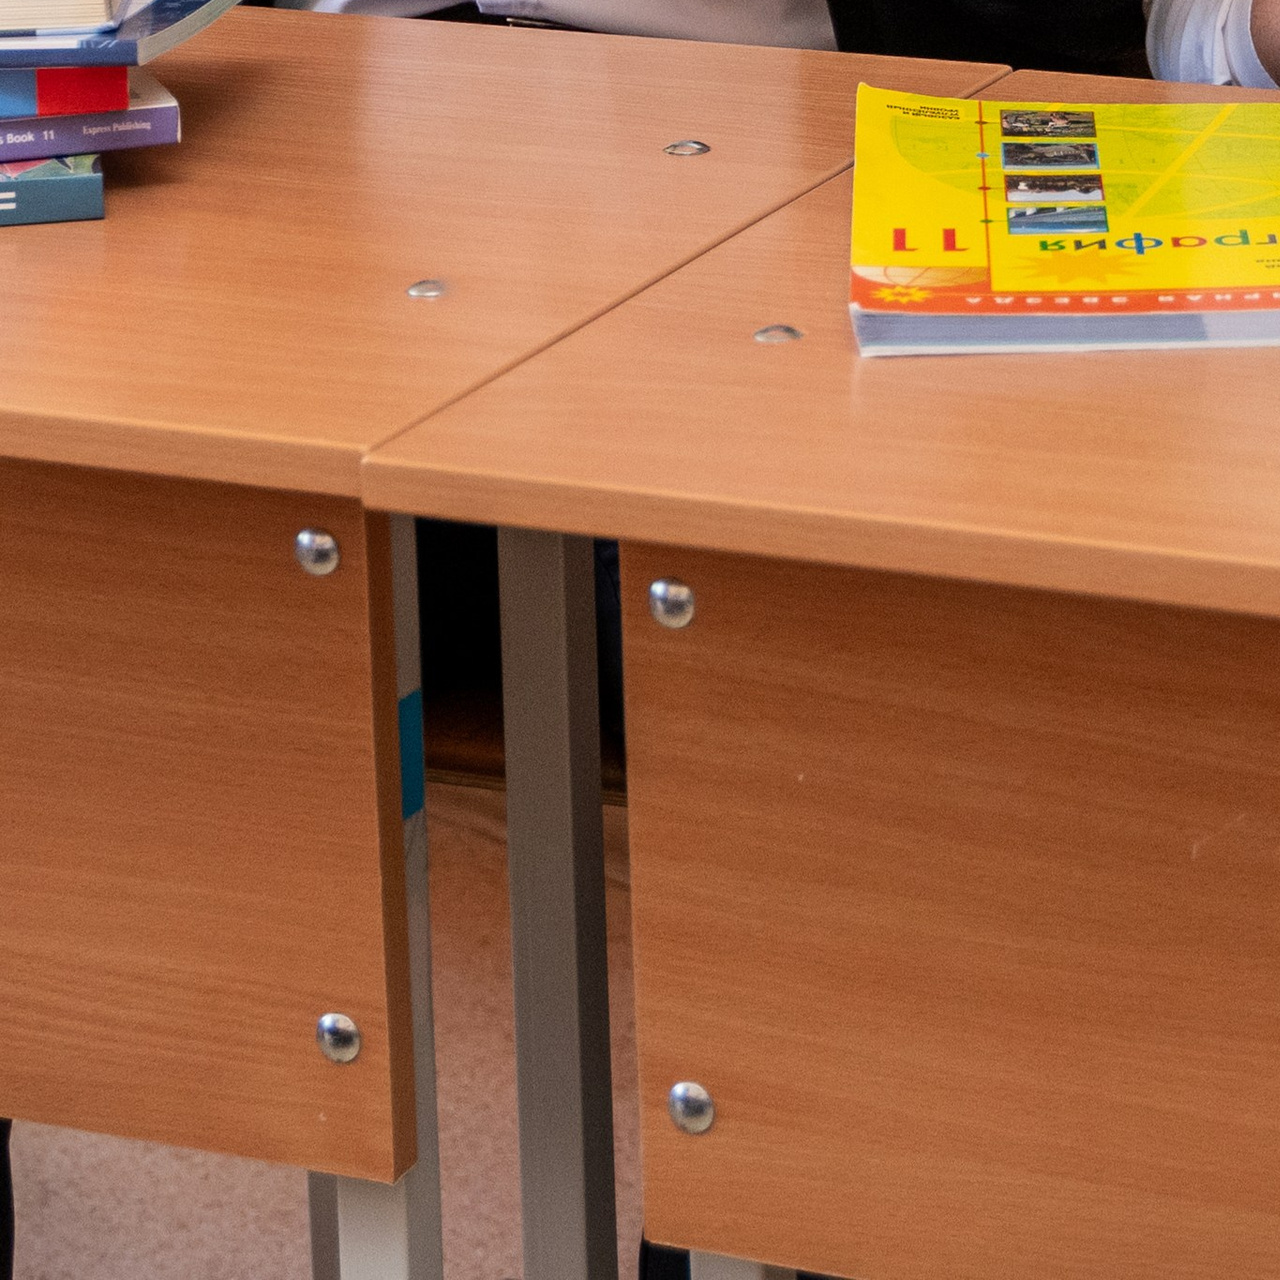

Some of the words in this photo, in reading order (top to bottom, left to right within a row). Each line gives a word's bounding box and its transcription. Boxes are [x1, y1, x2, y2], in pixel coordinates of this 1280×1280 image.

[82, 125, 112, 136] Express
[113, 120, 152, 133] Publishing
[6, 131, 35, 144] Book
[42, 129, 56, 141] 11
[892, 227, 970, 253] 11
